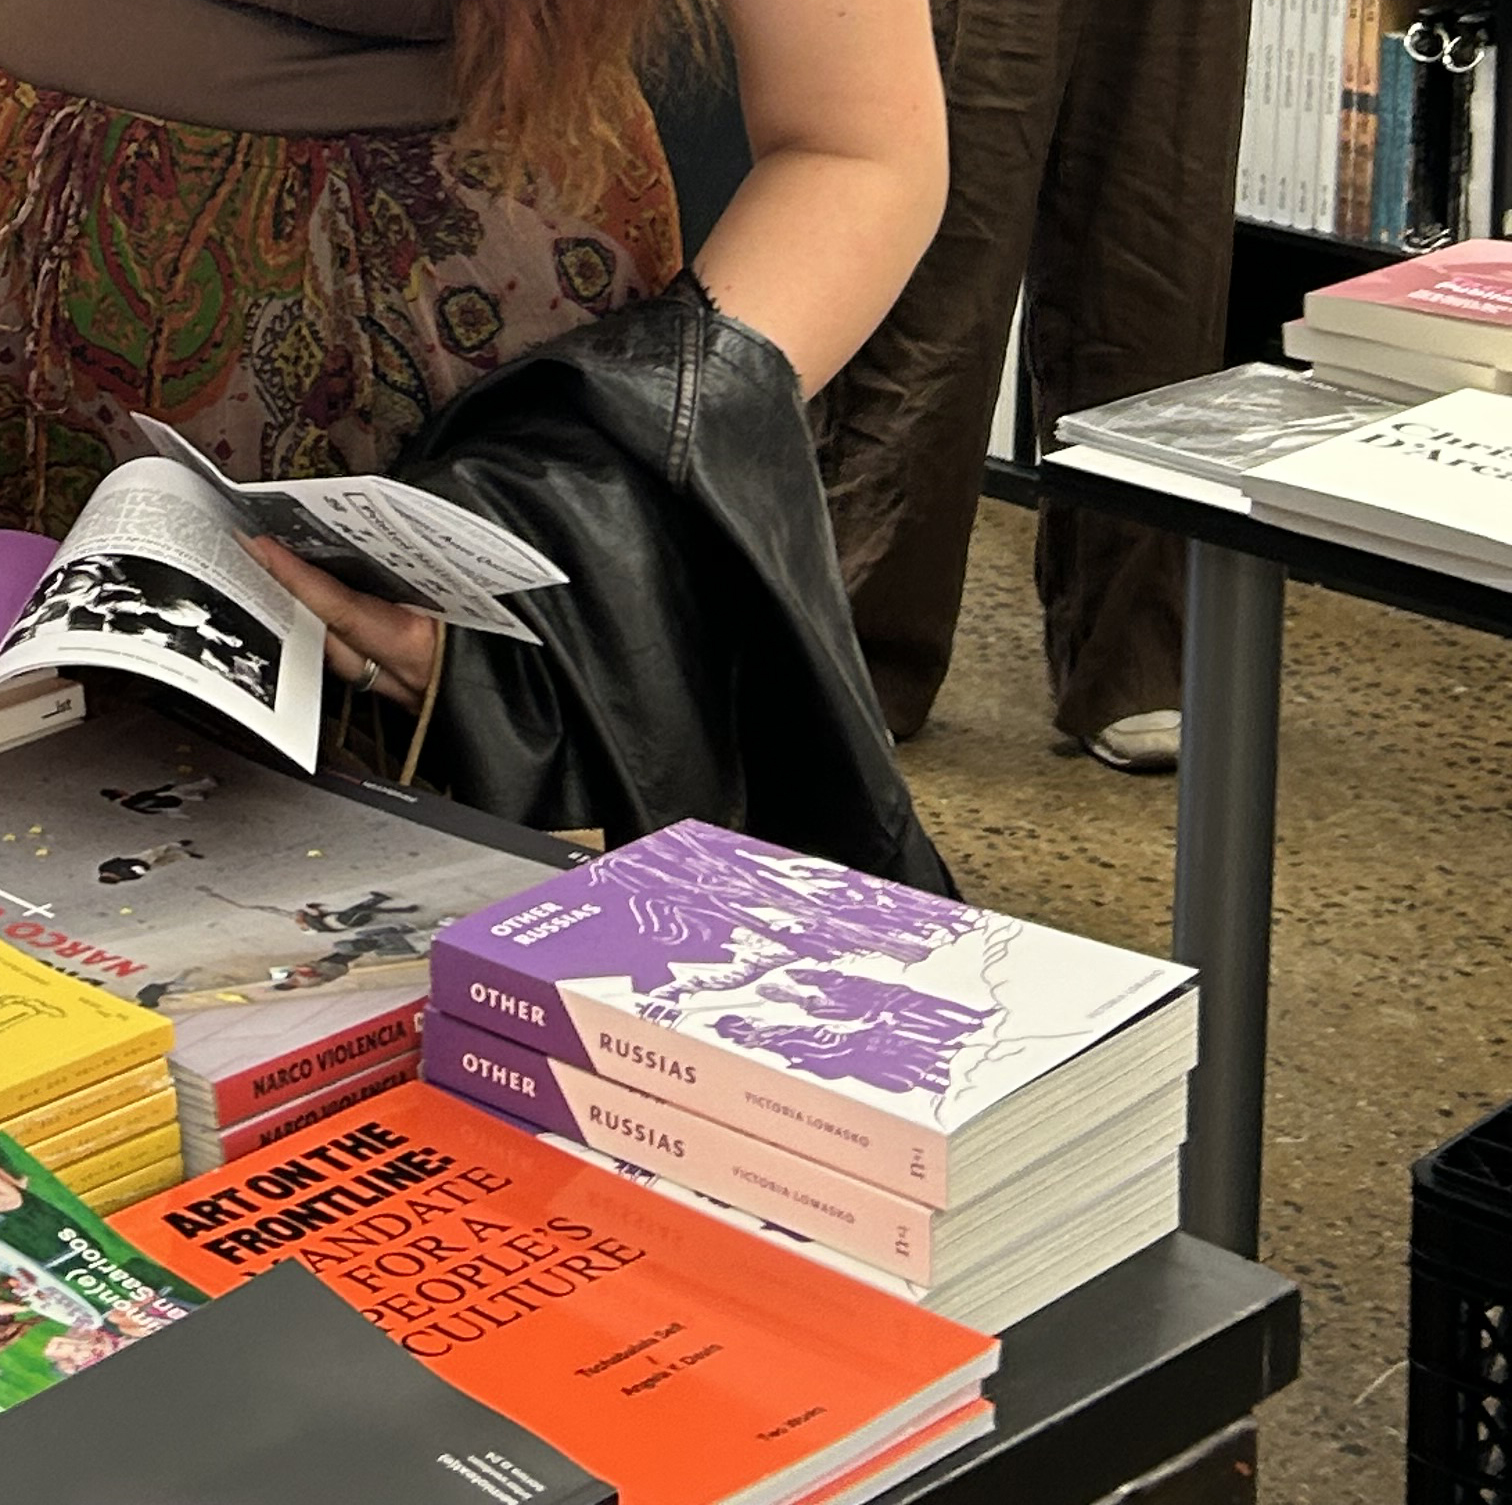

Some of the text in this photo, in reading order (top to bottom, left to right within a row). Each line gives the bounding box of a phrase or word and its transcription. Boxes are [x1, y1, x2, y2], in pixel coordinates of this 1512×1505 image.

[5, 921, 149, 979] NARCO
[489, 900, 564, 939] OTHER
[513, 902, 603, 948] RUSSIAS
[251, 1019, 410, 1100] NARCO VIOLENCIA
[469, 982, 872, 1150] OTHER RUSSIAS VICTORIA LOMASKO
[257, 1106, 320, 1149] NARCO
[461, 1051, 857, 1225] OTHER RUSSIAS VICTORIA LOMASKO
[162, 1120, 409, 1241] ART ON THE
[201, 1147, 457, 1266] FRONTLINE:
[343, 1217, 515, 1309] FOR A
[399, 1238, 648, 1359] CULTURE
